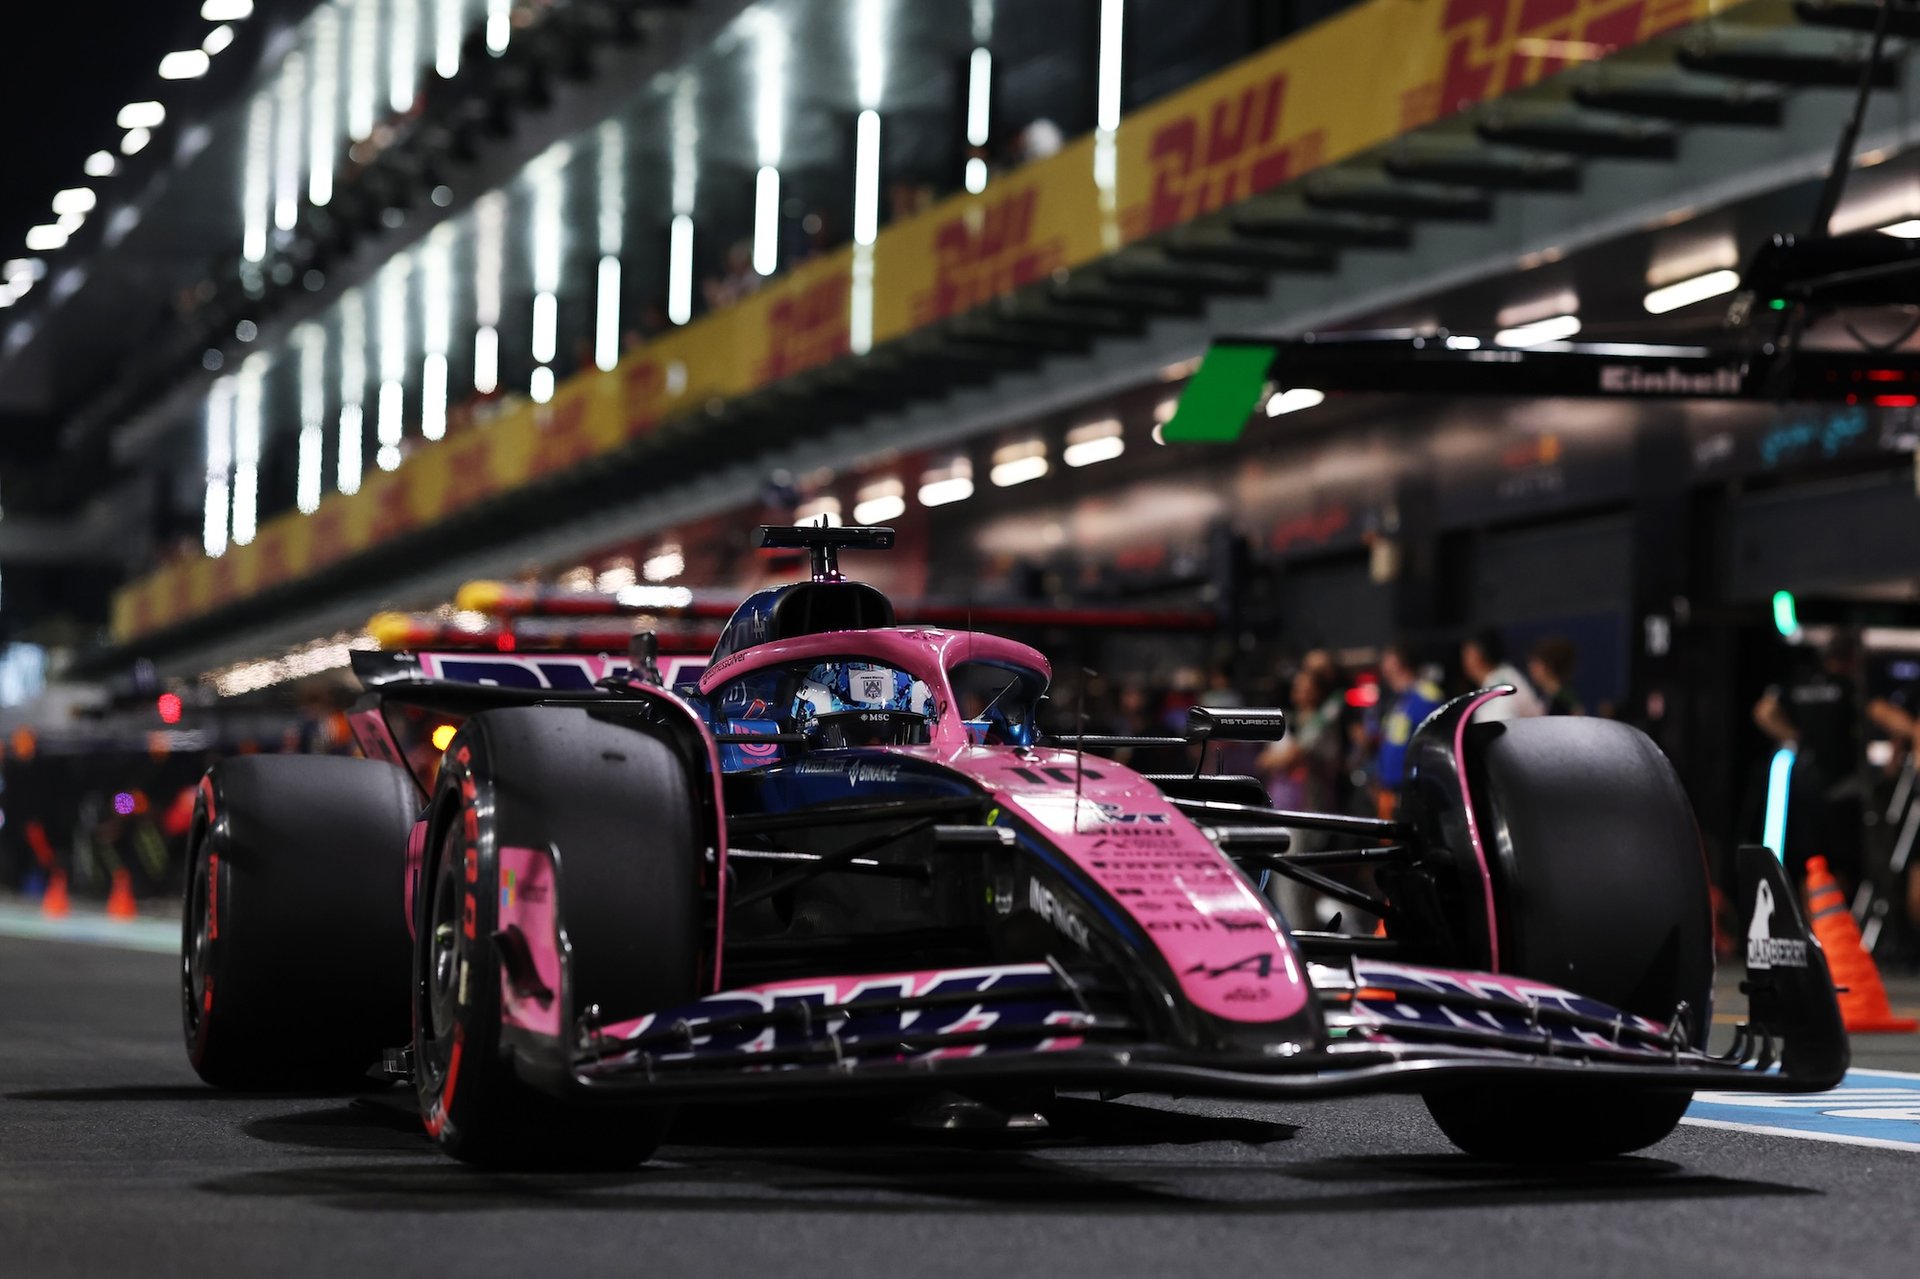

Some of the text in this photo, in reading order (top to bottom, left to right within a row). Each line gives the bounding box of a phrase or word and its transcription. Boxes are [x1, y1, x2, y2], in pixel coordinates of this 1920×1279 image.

[870, 713, 890, 721] MSC
[859, 763, 899, 782] BINANCE
[1000, 764, 1105, 785] 10
[1746, 938, 1808, 969] OAKBERRY
